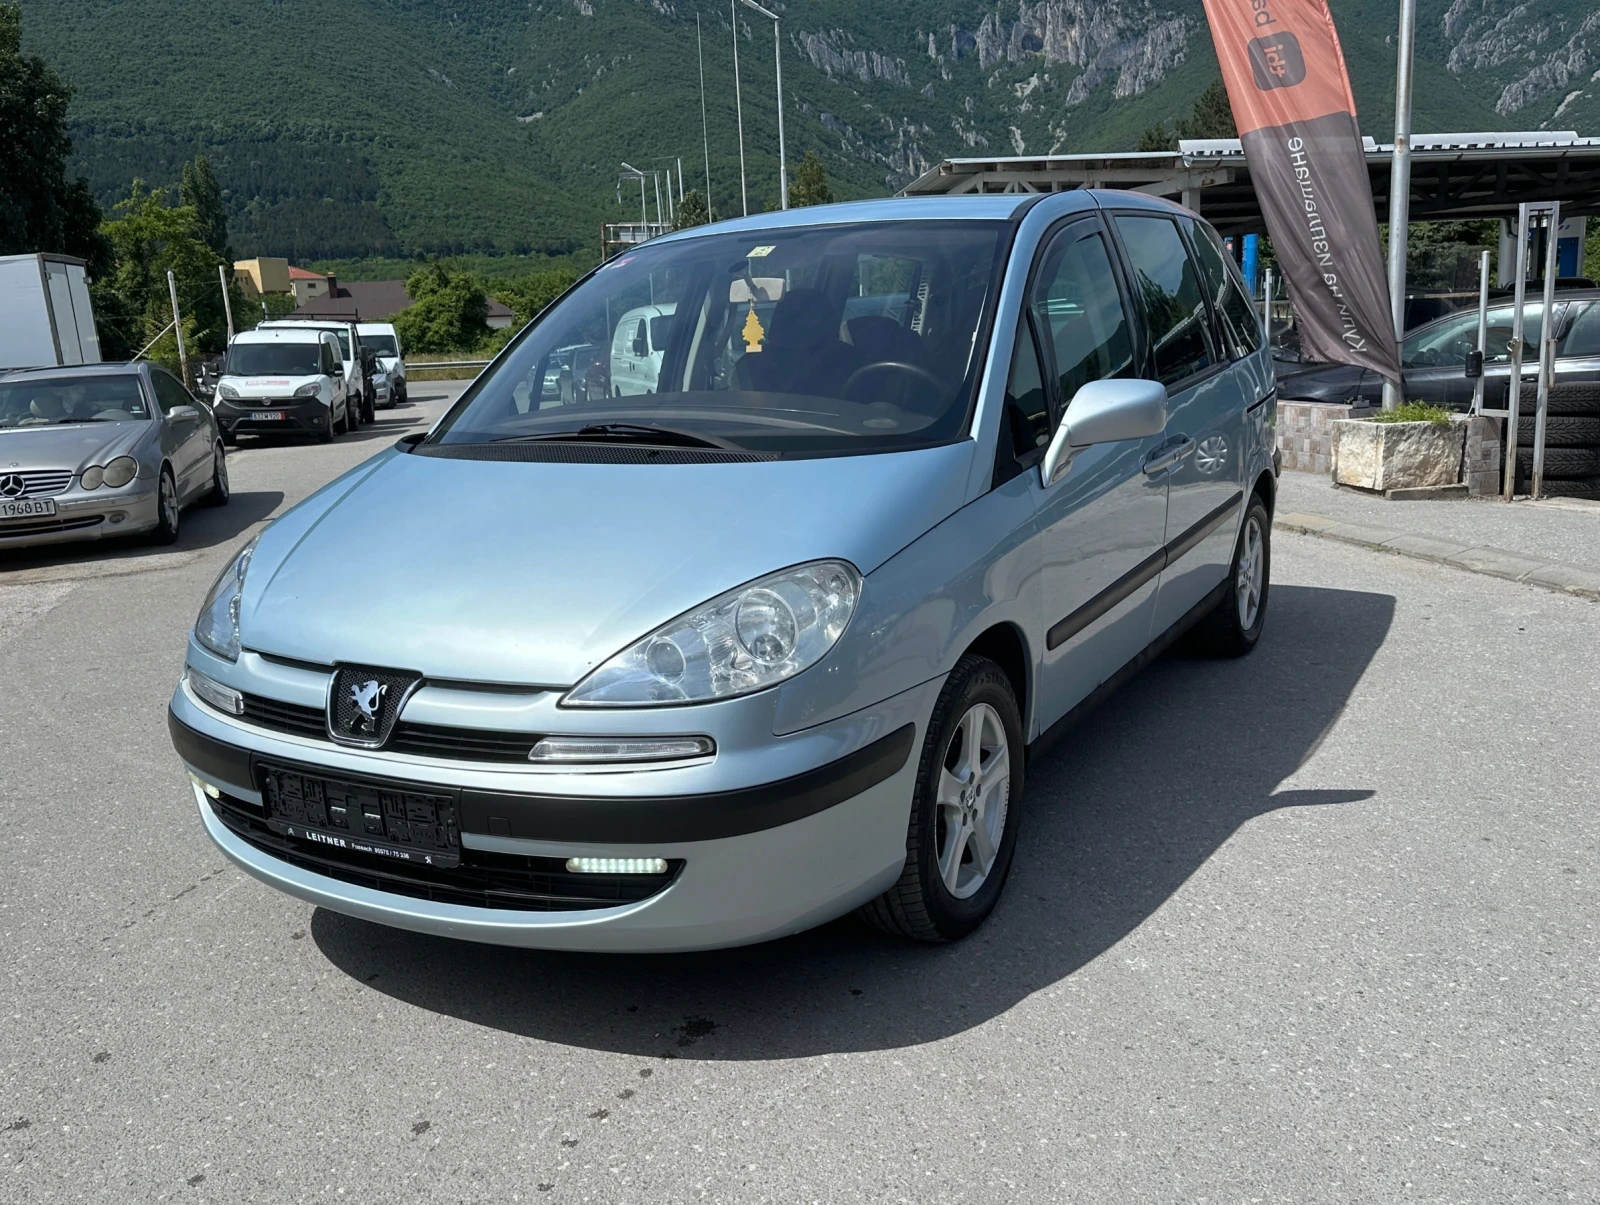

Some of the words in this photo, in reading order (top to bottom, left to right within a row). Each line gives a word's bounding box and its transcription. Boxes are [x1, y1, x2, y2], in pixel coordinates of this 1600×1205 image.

[2, 502, 32, 516] 1968
[34, 501, 51, 513] BT
[305, 831, 347, 848] LEITNER
